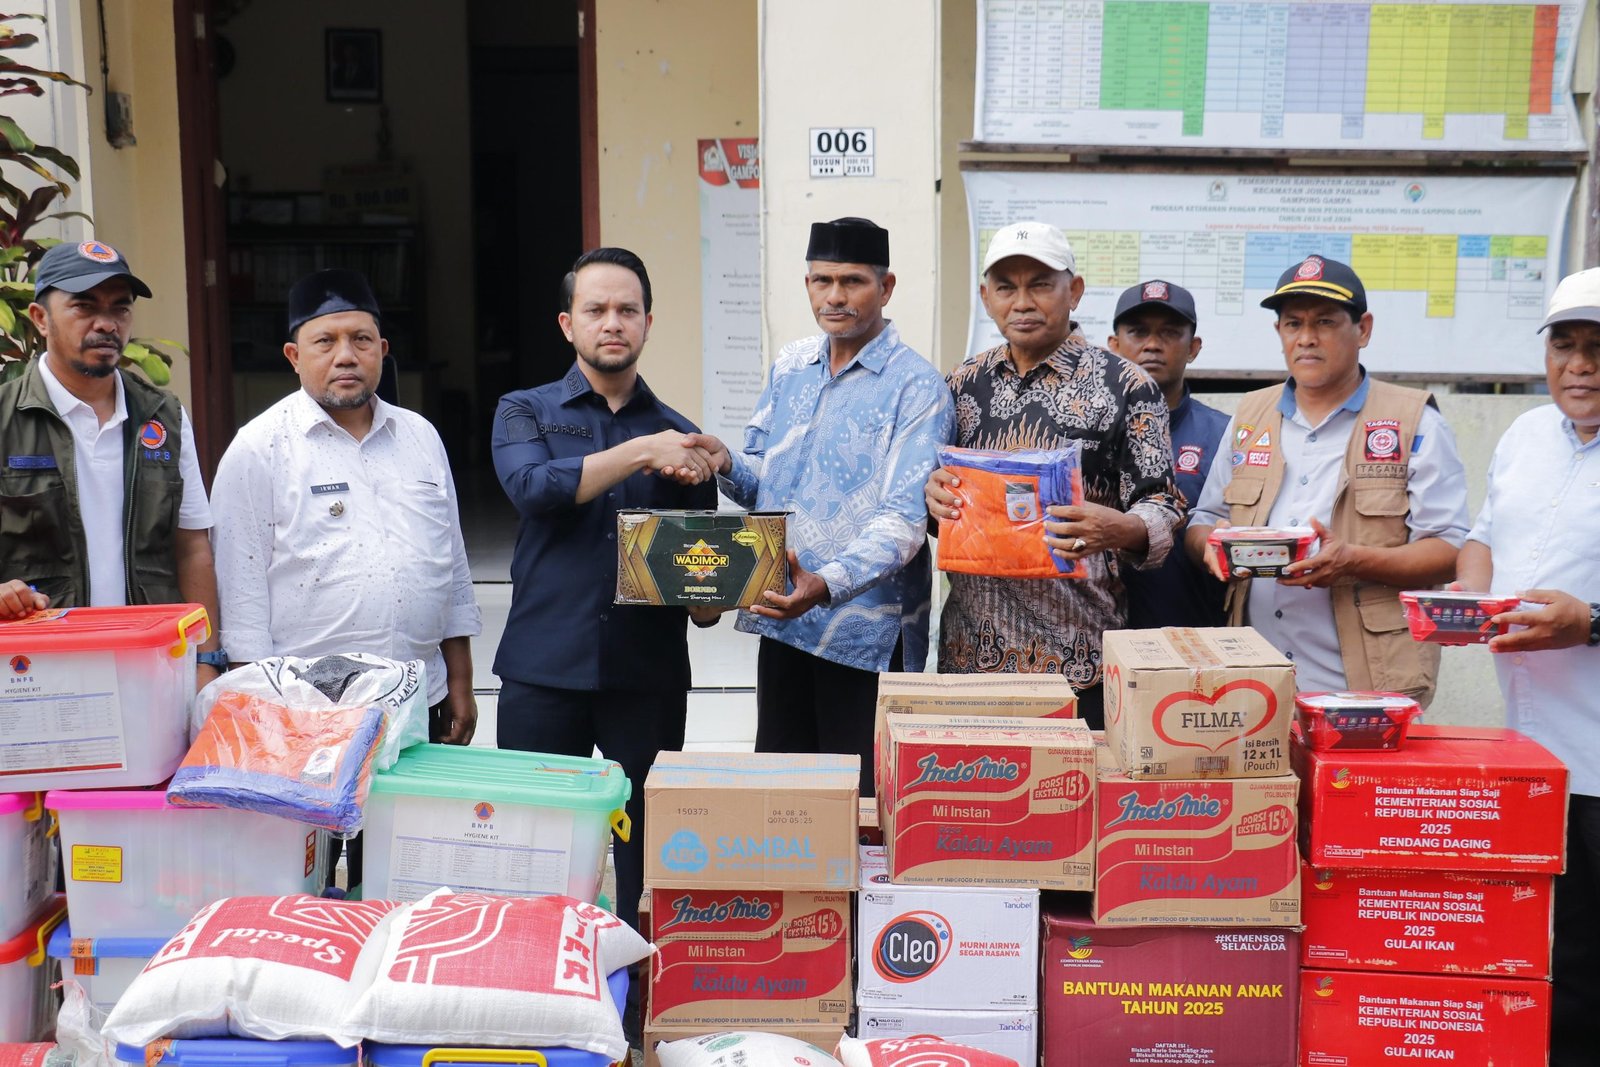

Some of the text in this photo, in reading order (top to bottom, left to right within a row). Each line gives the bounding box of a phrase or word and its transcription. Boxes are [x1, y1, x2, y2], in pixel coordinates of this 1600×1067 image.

[817, 132, 867, 153] 006
[813, 158, 840, 166] DUSUN
[1361, 465, 1405, 473] TAGANA
[675, 555, 727, 566] WADIMOR
[1181, 712, 1244, 728] FILMA
[1256, 739, 1279, 747] Bersih
[1242, 750, 1256, 759] 12
[1270, 749, 1282, 758] 1L
[903, 752, 1019, 790] Indomie
[1243, 759, 1279, 772] (Pouch)
[1035, 774, 1085, 798] EKSTRA 15%
[1040, 776, 1064, 789] PORSI
[1376, 787, 1500, 798] Bantuan Makanan Siap Saji
[1104, 790, 1220, 829] Indomie
[1375, 797, 1501, 809] KEMENTERIAN SOSIAL
[677, 808, 709, 816] 150373
[932, 805, 991, 818] Mi Instan
[1242, 811, 1267, 825] PORSI
[1375, 808, 1499, 820] REPUBLIK INDONESIA
[1238, 808, 1288, 834] EKSTRA 15%
[1419, 823, 1451, 835] 2025
[464, 832, 489, 840] HYGIENE
[716, 836, 816, 859] SAMBAL
[936, 836, 1053, 858] Kaldu Ayam
[1380, 837, 1491, 849] RENDANG DAGING
[1134, 844, 1193, 856] Mi Instan
[1139, 874, 1258, 896] Kaldu Ayam
[1359, 888, 1484, 901] Bantuan Makanan Siap Saji
[1358, 899, 1485, 912] KEMENTERIAN SOSIAL
[659, 895, 773, 932] Indomie
[1358, 910, 1484, 923] REPUBLIK INDONESIA
[818, 912, 837, 934] 15%
[1404, 925, 1435, 937] 2025
[959, 941, 1020, 950] MURNI AIRNYA
[1215, 934, 1285, 944] #KEMENSOS
[1384, 939, 1454, 951] GULAI IKAN
[210, 927, 346, 965] Special
[688, 945, 745, 957] Mi Instan
[889, 932, 936, 964] Cleo
[692, 975, 807, 996] Kaldu Ayam
[1063, 982, 1283, 998] BANTUAN MAKANAN ANAK
[1122, 1001, 1224, 1015] TAHUN 2025
[1359, 995, 1484, 1010] Bantuan Makanan Siap Saji
[1358, 1006, 1485, 1021] KEMENTERIAN SOSIAL
[999, 1023, 1032, 1032] Tanobel
[1358, 1017, 1484, 1032] REPUBLIK INDONESIA
[1404, 1033, 1435, 1044] 2025
[1384, 1046, 1454, 1059] GULAI IKAN
